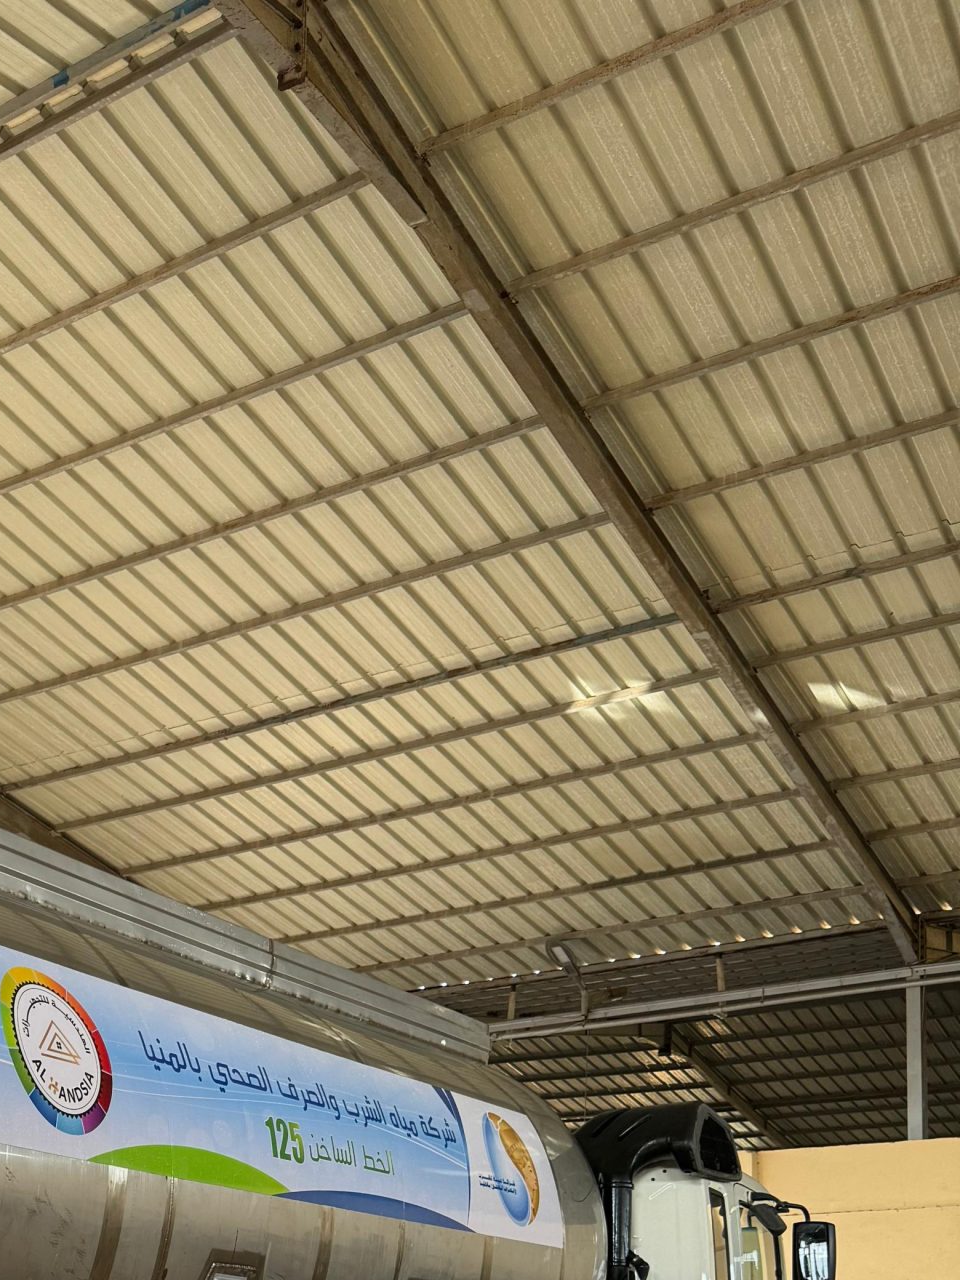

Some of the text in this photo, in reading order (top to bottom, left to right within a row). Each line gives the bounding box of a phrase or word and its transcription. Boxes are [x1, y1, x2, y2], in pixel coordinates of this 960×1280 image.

[138, 1030, 457, 1149] شركة مياه الشرب والصرف الصحي بالمنيا
[265, 1116, 395, 1175] الخط الساخن 125
